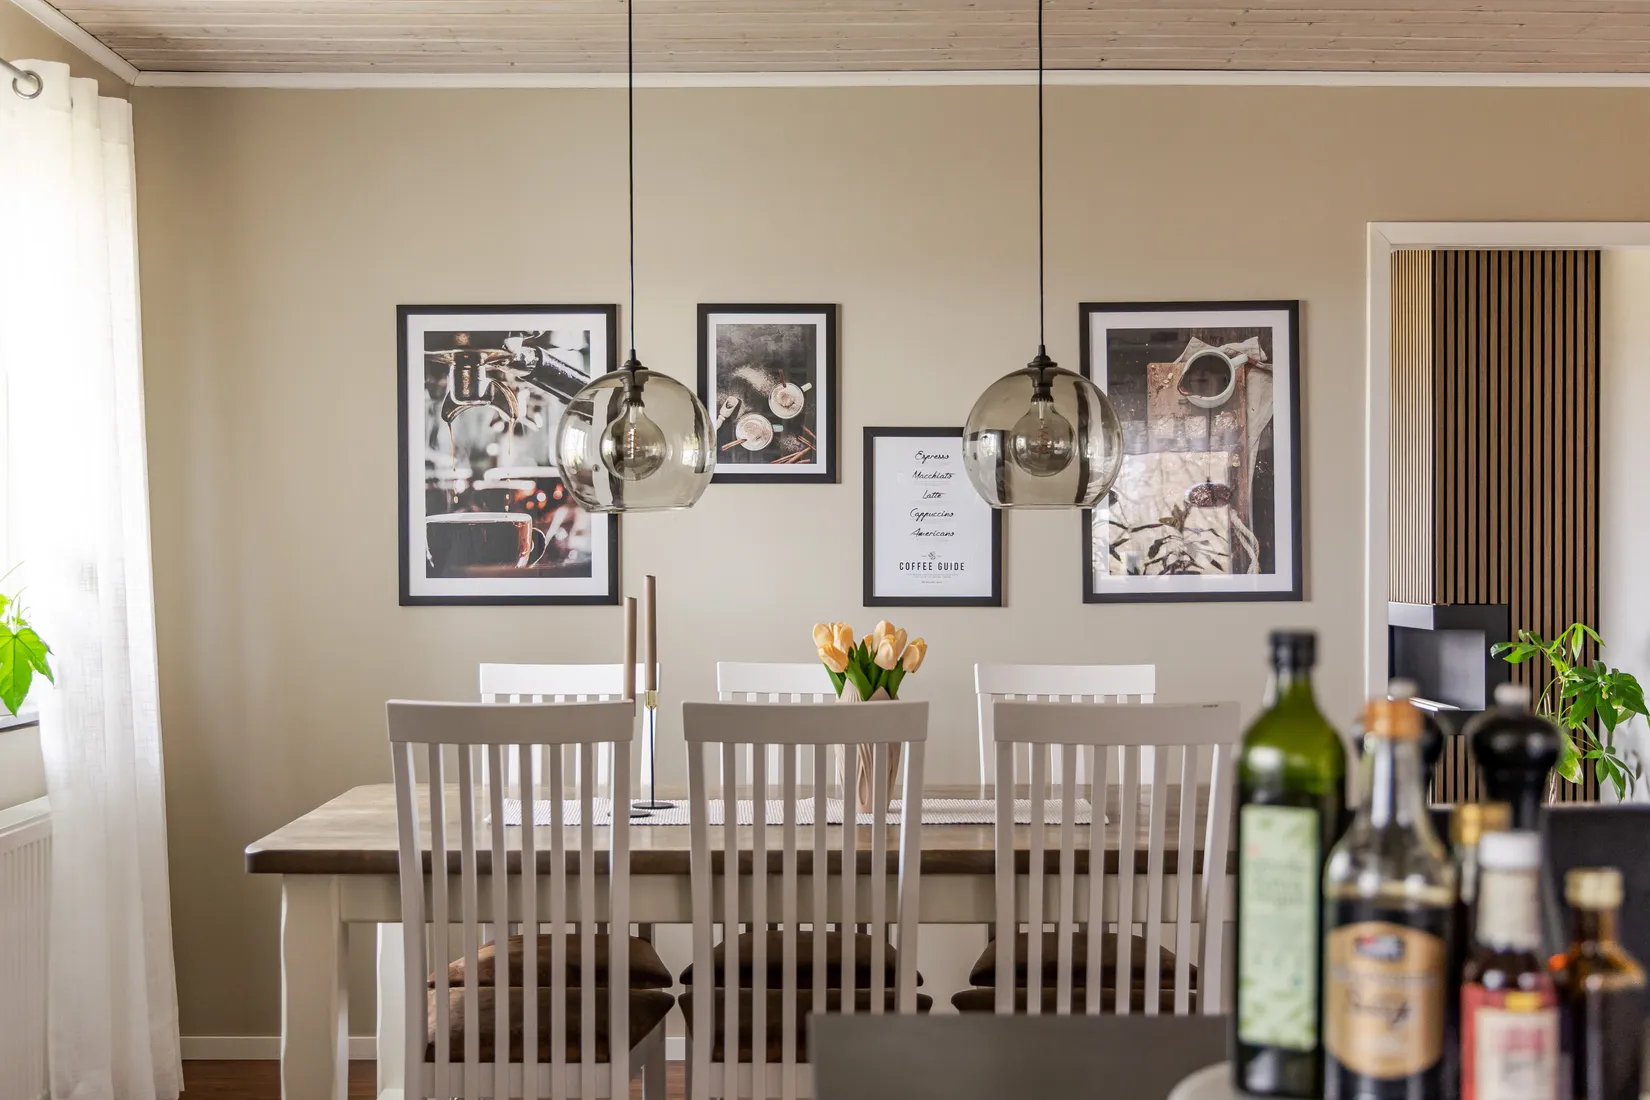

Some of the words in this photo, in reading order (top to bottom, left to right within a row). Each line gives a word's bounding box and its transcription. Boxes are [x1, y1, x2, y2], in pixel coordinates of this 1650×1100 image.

[915, 450, 949, 464] Espresso
[912, 470, 955, 480] Macchiato
[922, 490, 945, 500] Latte
[910, 508, 954, 522] Cappuccino
[910, 528, 955, 538] Americano
[899, 562, 933, 571] COFFEE
[937, 562, 965, 571] GUIDE
